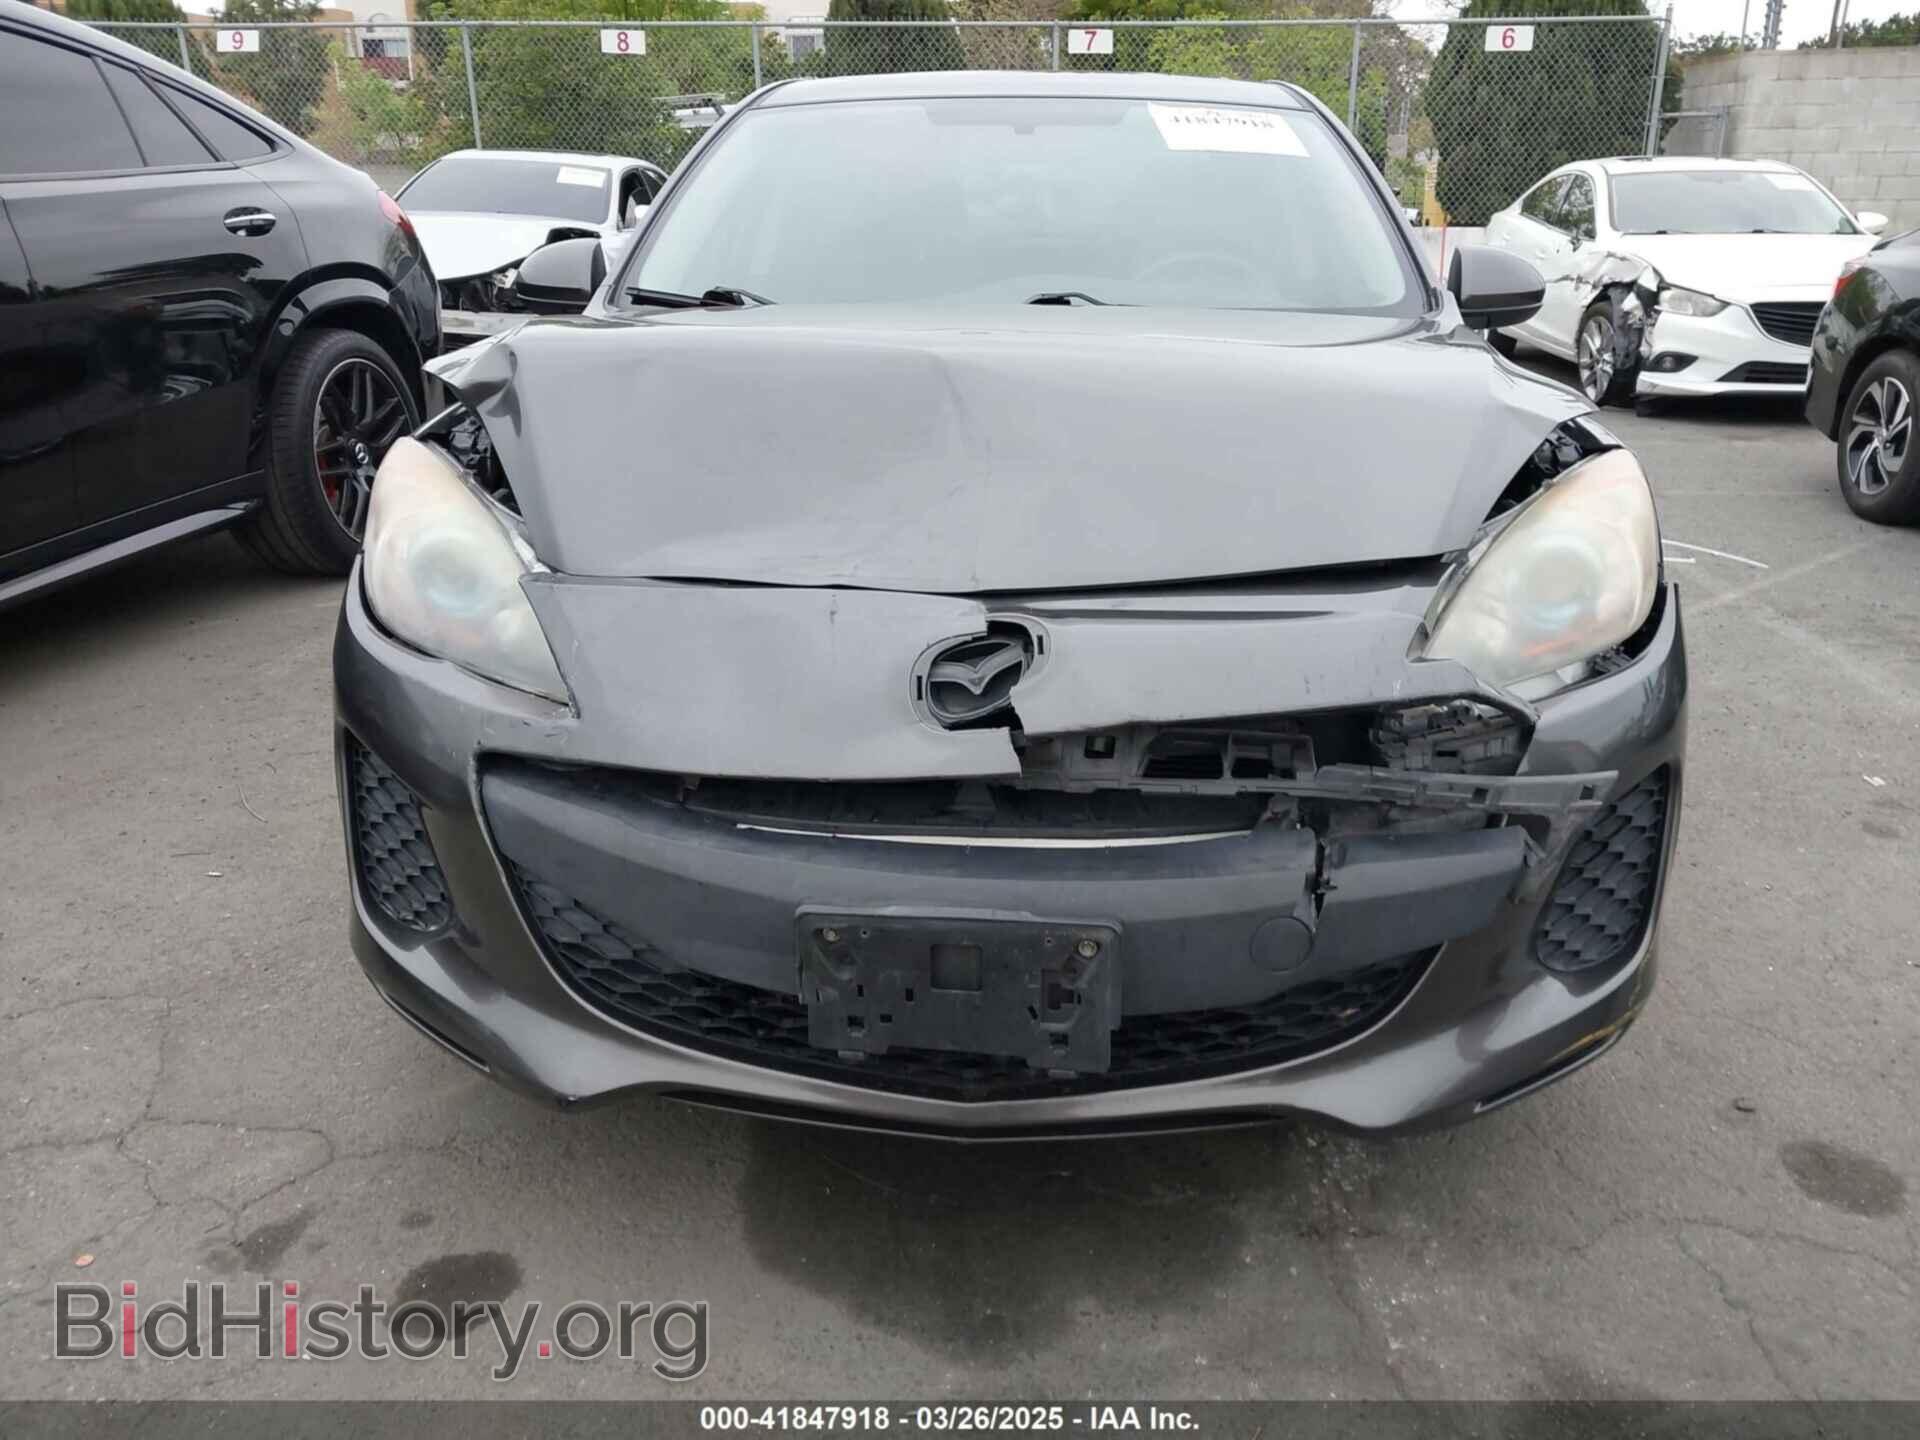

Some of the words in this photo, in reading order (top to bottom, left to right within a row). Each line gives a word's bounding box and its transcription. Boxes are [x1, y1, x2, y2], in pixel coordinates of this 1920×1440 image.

[231, 31, 244, 50] 9
[616, 31, 630, 52] 8
[1084, 30, 1098, 51] 7
[1501, 28, 1516, 49] 6
